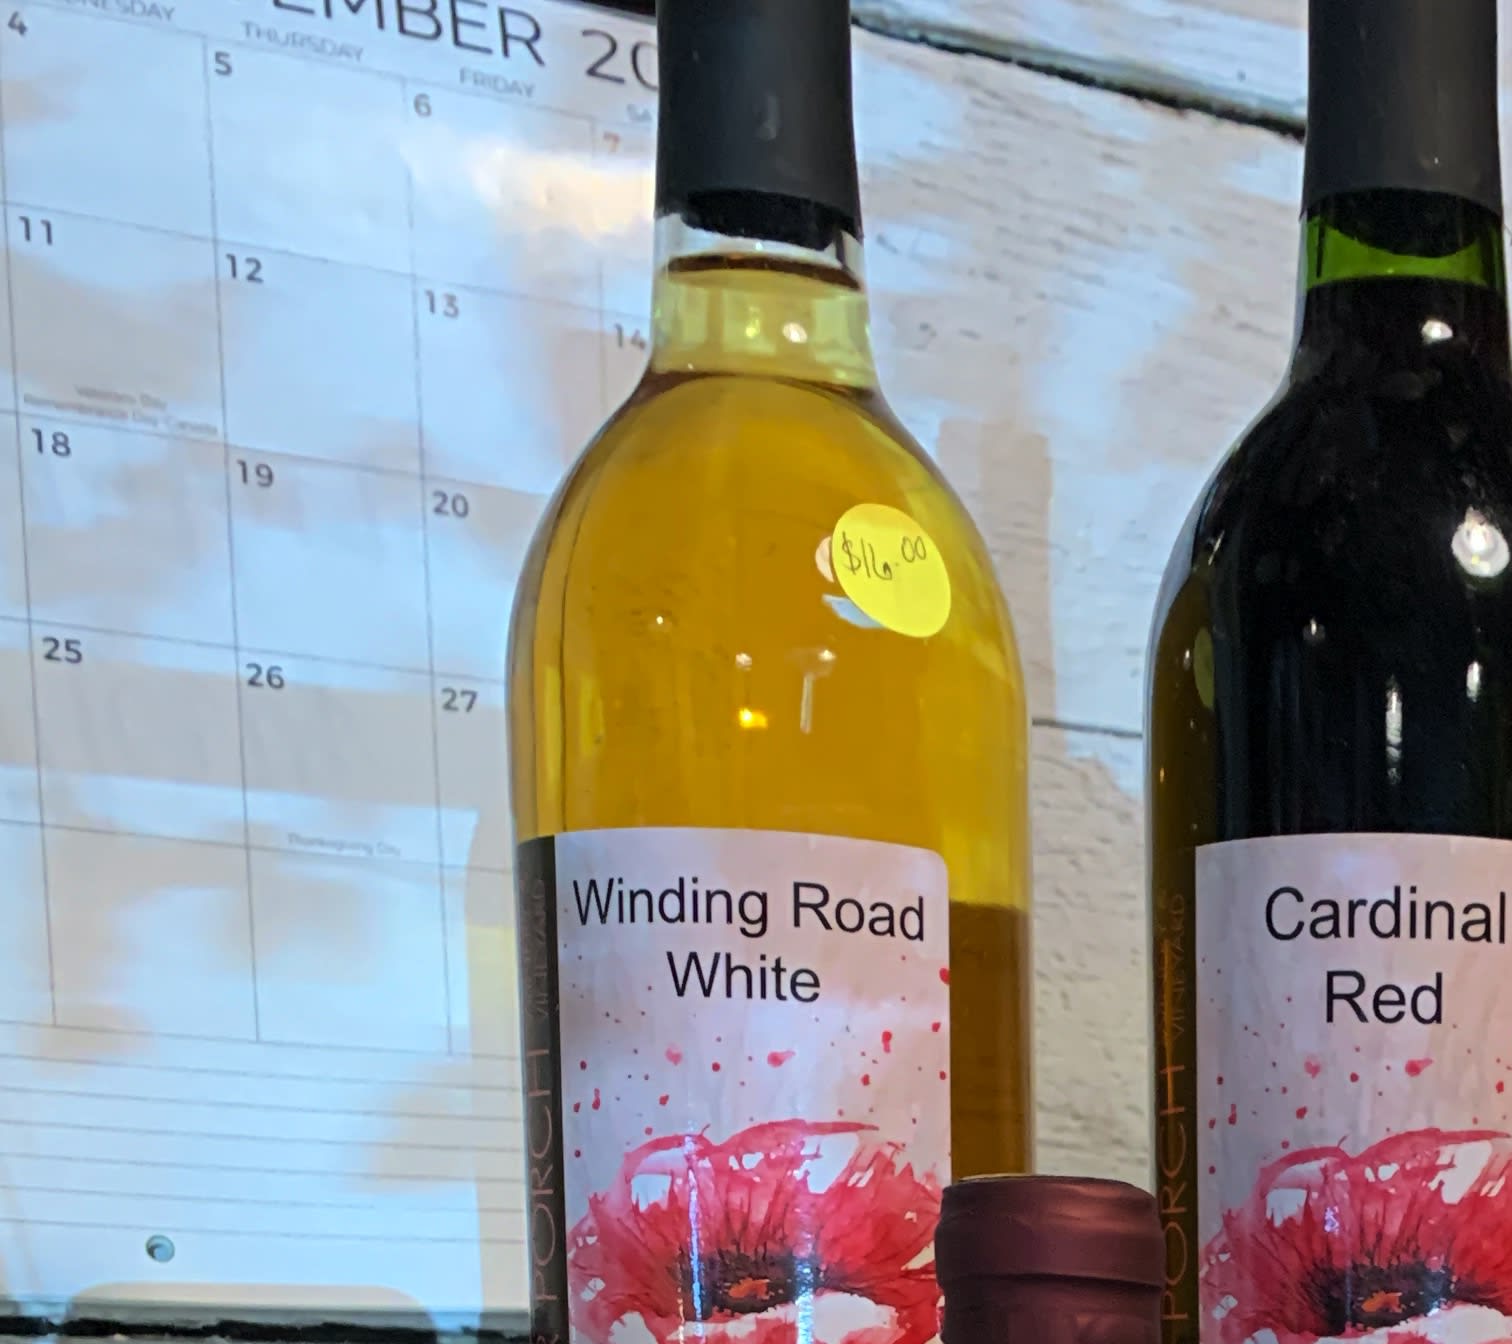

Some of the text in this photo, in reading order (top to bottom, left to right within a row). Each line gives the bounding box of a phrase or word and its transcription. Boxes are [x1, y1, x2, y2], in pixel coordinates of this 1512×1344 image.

[8, 11, 621, 154] 4 5 6 7
[242, 20, 364, 63] THURSDAY
[459, 67, 539, 99] FRIDAY
[18, 216, 647, 352] 11 12 13 14
[30, 427, 470, 520] 18 19 20
[842, 531, 927, 581] $16.00
[43, 637, 479, 714] 25 26 27
[573, 877, 925, 942] Winding Road
[1265, 885, 1506, 945] Cardinal
[667, 951, 821, 1003] White
[1326, 970, 1443, 1025] Red
[525, 1048, 560, 1302] PORCH
[1159, 1064, 1190, 1321] PORCH
